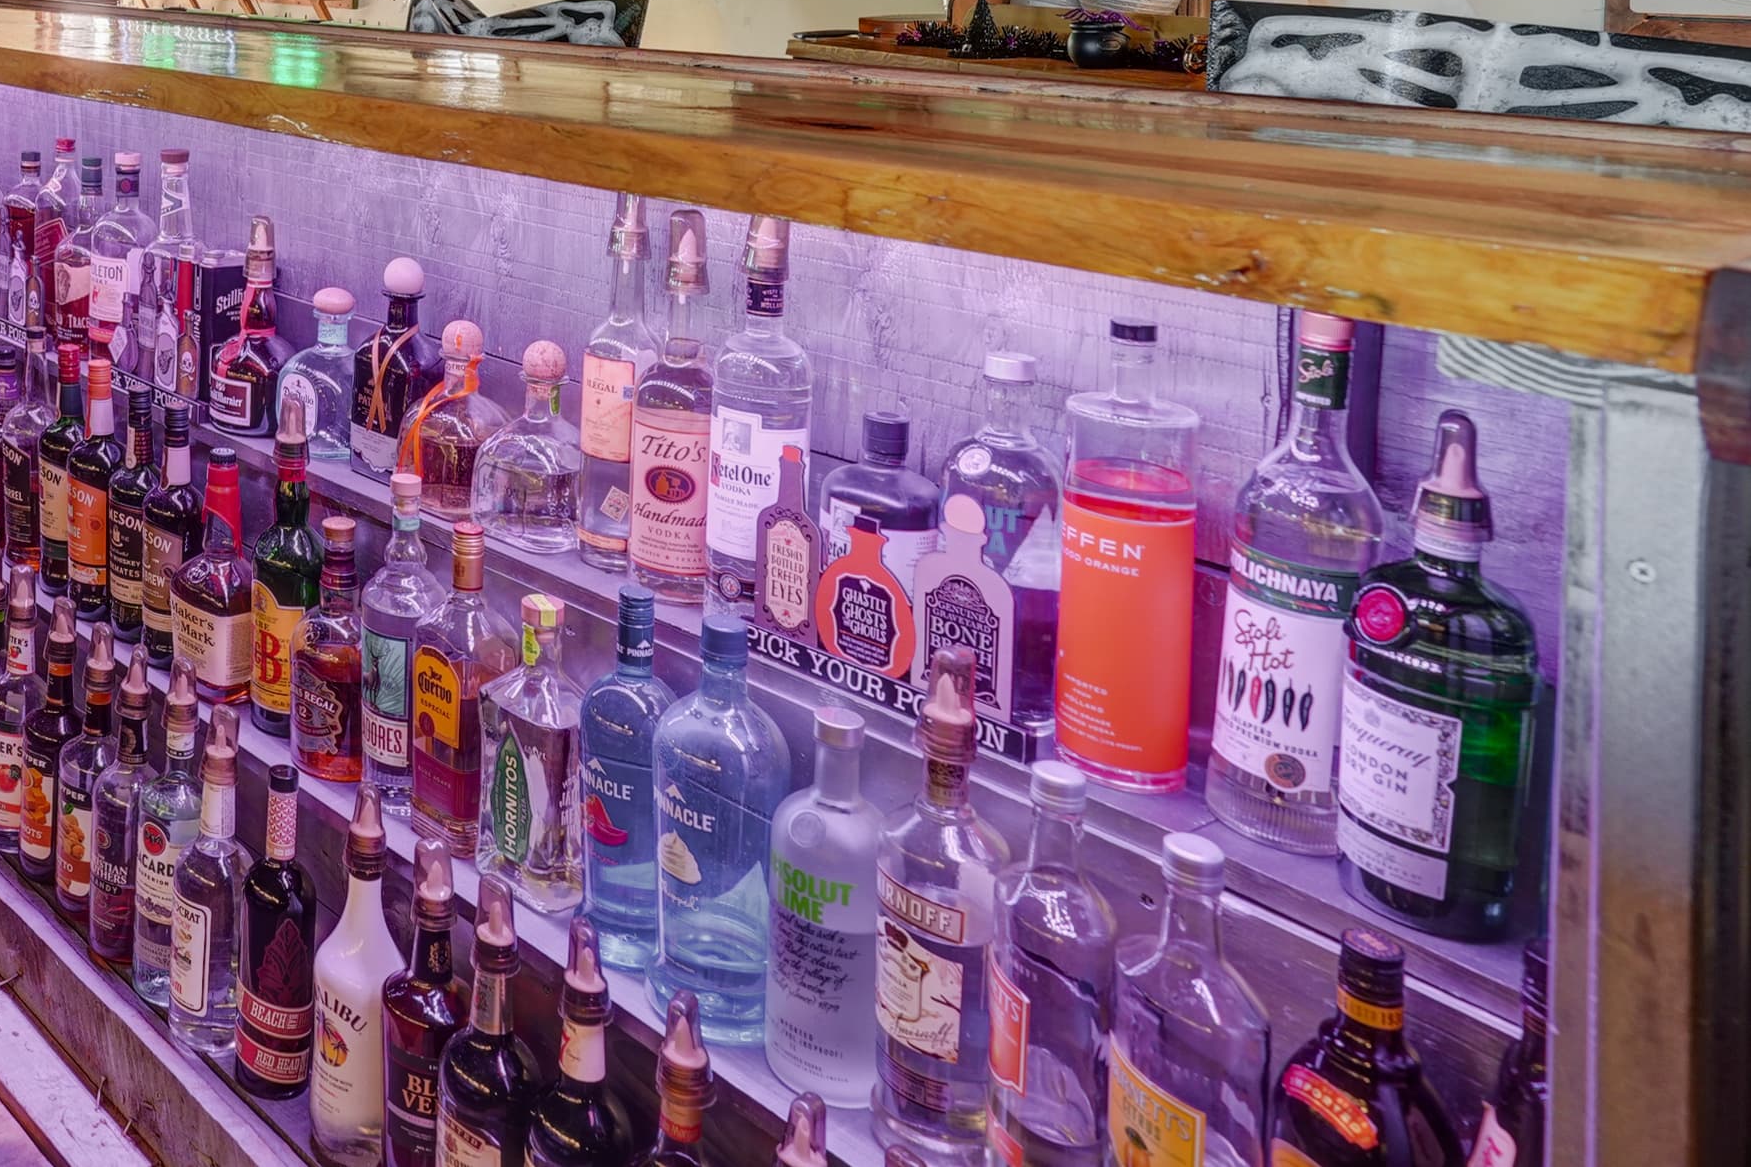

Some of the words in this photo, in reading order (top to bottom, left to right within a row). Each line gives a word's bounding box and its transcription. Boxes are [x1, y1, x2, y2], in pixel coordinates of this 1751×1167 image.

[741, 466, 771, 487] One
[721, 483, 752, 496] VODKA
[647, 526, 691, 541] VODKA
[771, 555, 804, 573] BOTTLED
[772, 543, 804, 561] FRESHLY
[771, 564, 803, 586] CREEPY
[1084, 557, 1139, 577] ORANGE
[771, 580, 803, 605] EYES
[842, 587, 888, 613] GHASTLY
[841, 602, 888, 631] GHOSTS
[932, 608, 991, 633] GRAVEYARD
[938, 602, 985, 623] GENUINE
[180, 621, 215, 647] Mark
[849, 620, 887, 644] GHOULS
[931, 616, 993, 650] BONE
[1234, 608, 1283, 645] Stoli
[1247, 640, 1294, 672] Hot
[418, 670, 453, 705] Cuervo
[805, 649, 886, 702] YOUR
[303, 691, 336, 714] REGAL
[1373, 772, 1408, 795] GIN
[503, 755, 518, 854] HORNITOS
[250, 1000, 287, 1030] BEACH
[255, 1049, 275, 1067] RED
